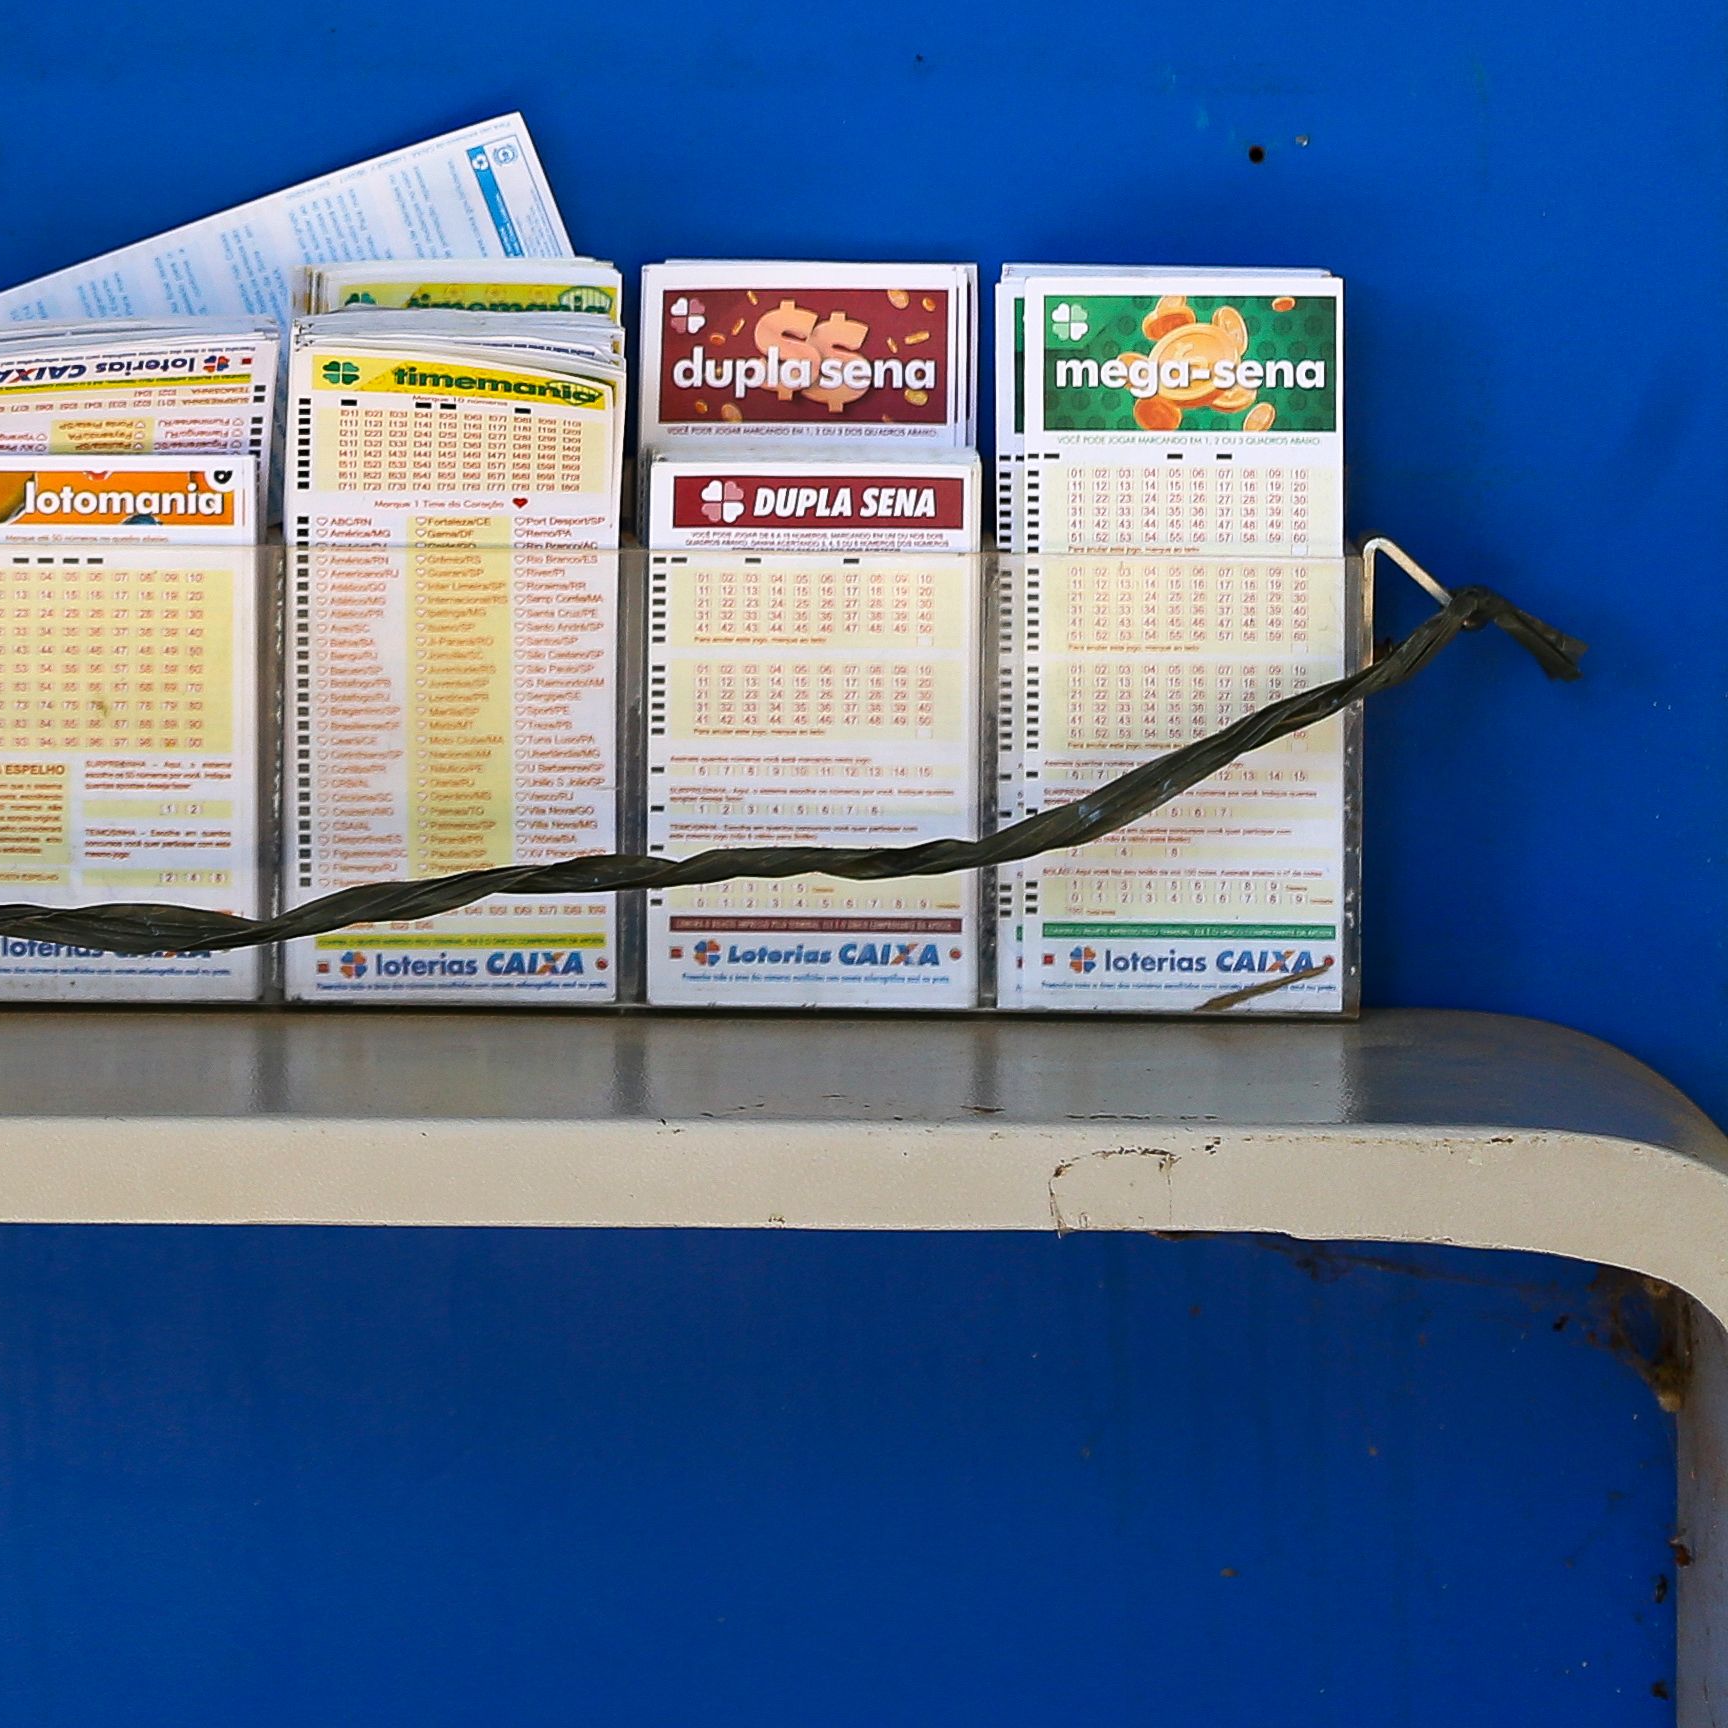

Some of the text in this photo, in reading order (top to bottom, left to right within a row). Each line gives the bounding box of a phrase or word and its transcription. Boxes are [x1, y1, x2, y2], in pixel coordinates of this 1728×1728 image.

[95, 357, 195, 377] loterias
[673, 346, 935, 399] dupla sena
[1056, 358, 1325, 398] mega-sena
[395, 366, 603, 403] timemania
[412, 395, 450, 404] Marque
[667, 425, 689, 436] VOCÊ
[691, 426, 712, 435] PODE
[715, 426, 741, 435] JOGAR
[744, 427, 790, 436] MARCANDO
[823, 428, 835, 436] OU
[845, 428, 862, 437] DOS
[864, 428, 905, 437] QUADROS
[1057, 435, 1081, 445] VOCÊ
[1083, 436, 1105, 444] PODE
[1108, 436, 1136, 444] JOGAR
[1138, 436, 1188, 444] MARCANDO
[1189, 436, 1202, 445] EM
[1222, 436, 1237, 445] OU
[1246, 436, 1288, 445] QUADROS
[24, 481, 224, 515] lotomania
[374, 501, 410, 510] Marque
[422, 500, 446, 508] Time
[754, 488, 936, 518] DUPLA SENA
[5, 765, 64, 775] ESPELHO
[376, 951, 584, 976] loterias CAIXA
[728, 944, 940, 966] Loterias CAIXA
[1105, 950, 1314, 973] loterias CAIXA
